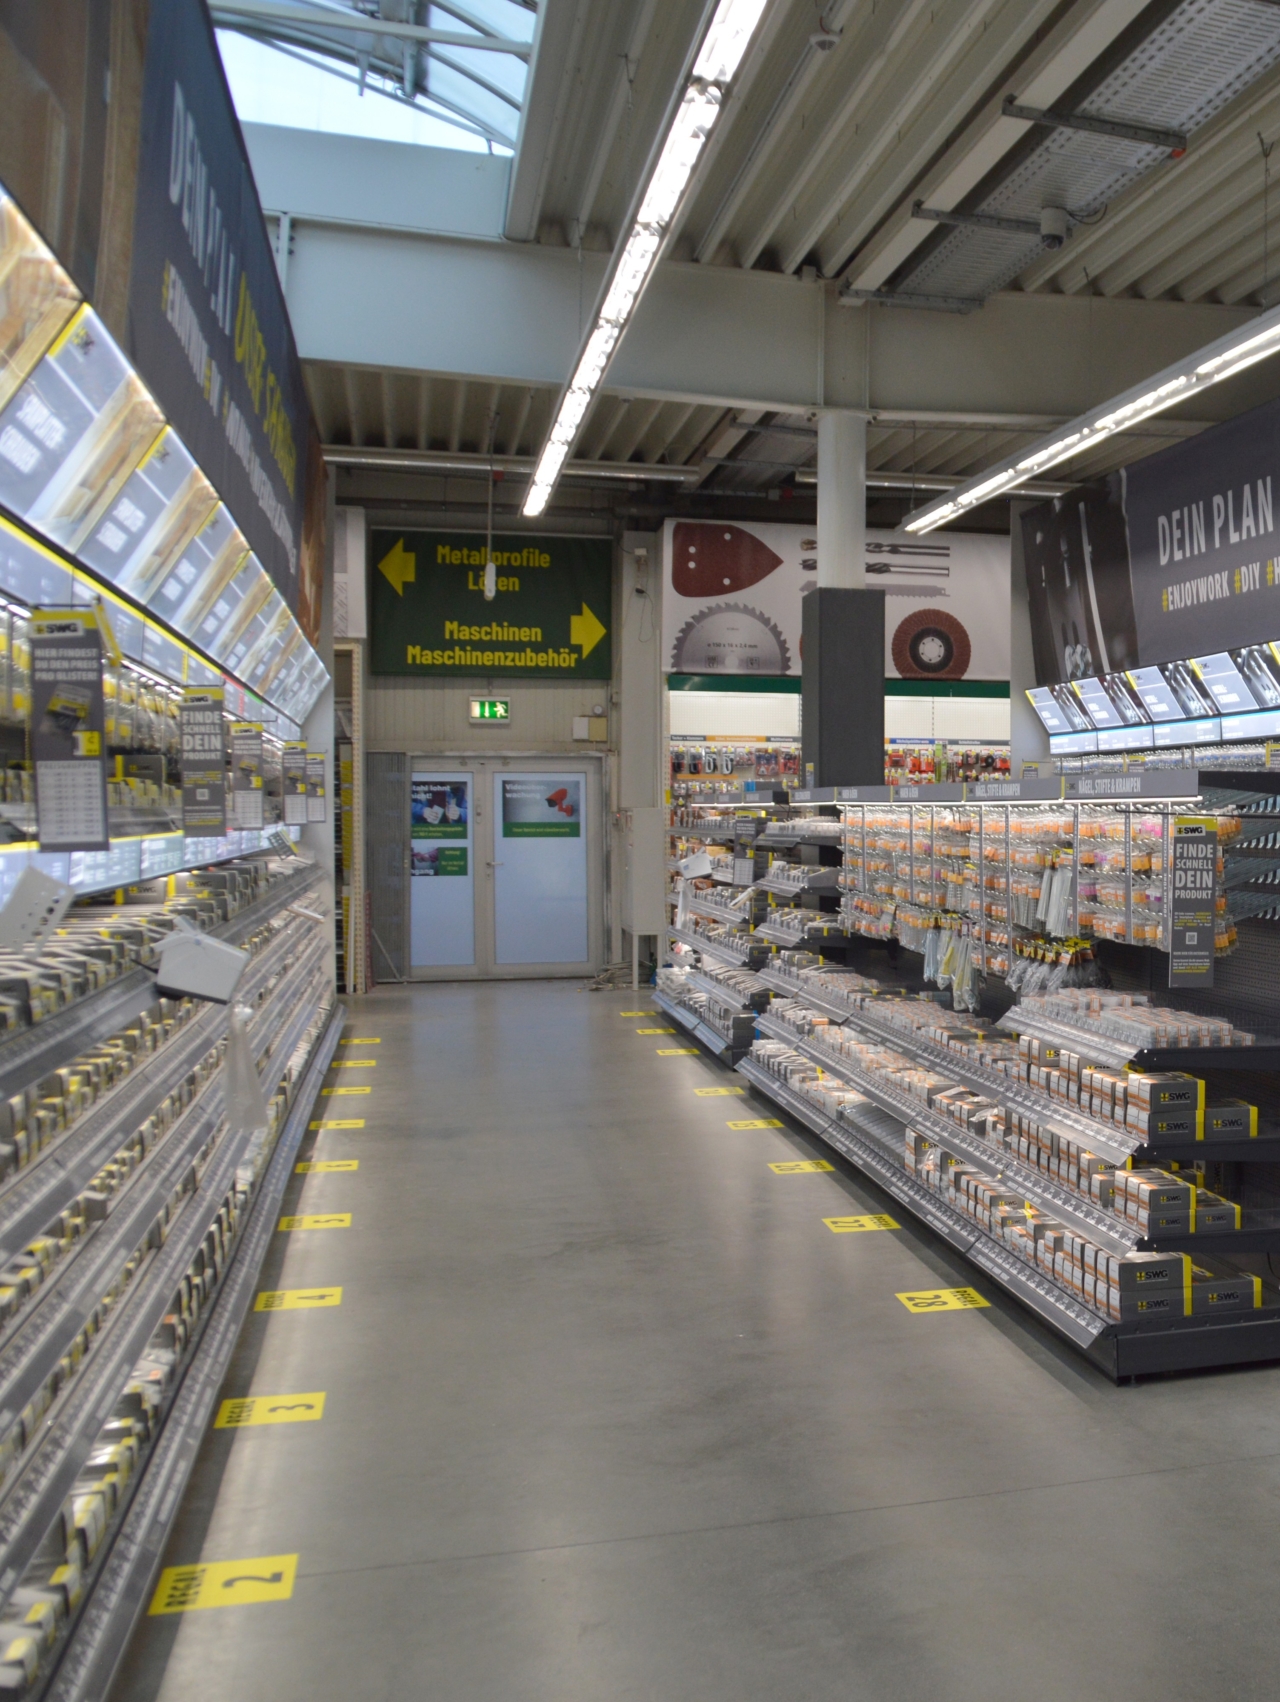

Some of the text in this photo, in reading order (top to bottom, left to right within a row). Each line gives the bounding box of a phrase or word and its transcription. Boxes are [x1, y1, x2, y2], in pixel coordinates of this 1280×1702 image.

[1157, 501, 1206, 566] DEIN
[1212, 476, 1274, 548] PLAN
[468, 571, 520, 591] Löen
[1162, 571, 1230, 612] #ENJOYWORK
[1234, 562, 1260, 595] #DIY
[46, 622, 78, 634] SWG
[445, 620, 542, 642] Maschinen
[35, 648, 97, 658] HIER FINDEST
[407, 645, 578, 667] Maschinenzubehör
[35, 660, 97, 669] DU DEN PREIS
[182, 711, 221, 723] FINDE
[182, 725, 221, 733] SCHNELL
[183, 735, 221, 749] DEIN
[184, 752, 221, 760] PRODUKT
[1078, 778, 1094, 795] NÄGEL,
[1095, 780, 1111, 793] STIFTE
[1116, 778, 1141, 792] KRAMPEN
[1176, 843, 1214, 858] FINDE
[1176, 859, 1212, 869] SCHNELL
[1175, 870, 1212, 888] DEIN
[1175, 890, 1212, 899] PRODUKT
[1169, 1091, 1190, 1101] SWG
[1167, 1122, 1189, 1131] SWG
[1222, 1118, 1243, 1128] SWG
[1166, 1195, 1181, 1203] SWG
[830, 1219, 866, 1228] 27
[1165, 1218, 1181, 1226] SWG
[1145, 1269, 1168, 1279] SWG
[905, 1294, 948, 1308] 28
[949, 1290, 981, 1306] REGAL
[1217, 1291, 1239, 1301] SWG
[1147, 1299, 1169, 1309] SWG
[268, 1403, 315, 1412] 3
[222, 1571, 284, 1588] 2
